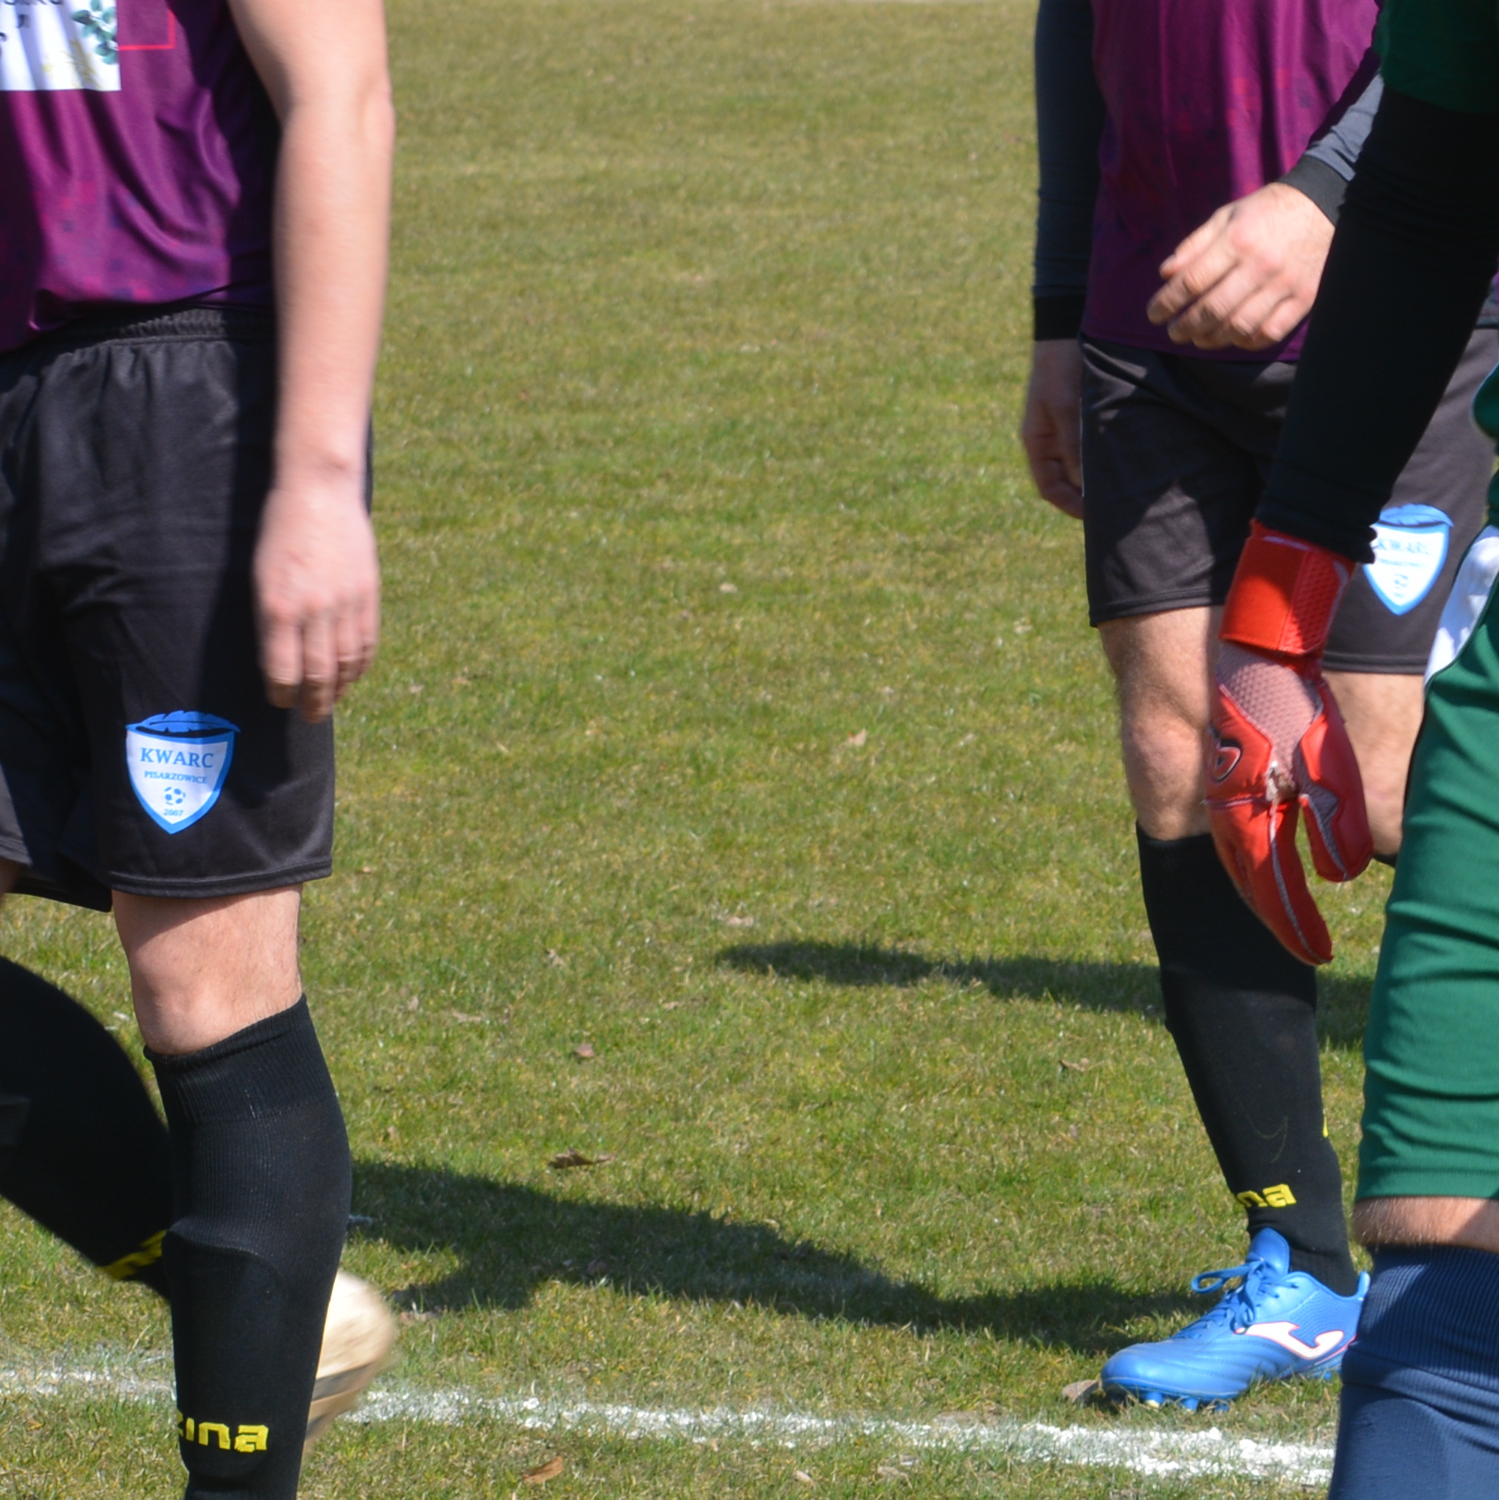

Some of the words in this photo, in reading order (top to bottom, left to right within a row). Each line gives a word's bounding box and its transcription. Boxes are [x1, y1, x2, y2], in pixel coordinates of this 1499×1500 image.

[139, 746, 215, 769] KWARC
[143, 770, 208, 784] PISARZOWICE
[163, 807, 184, 817] 2007
